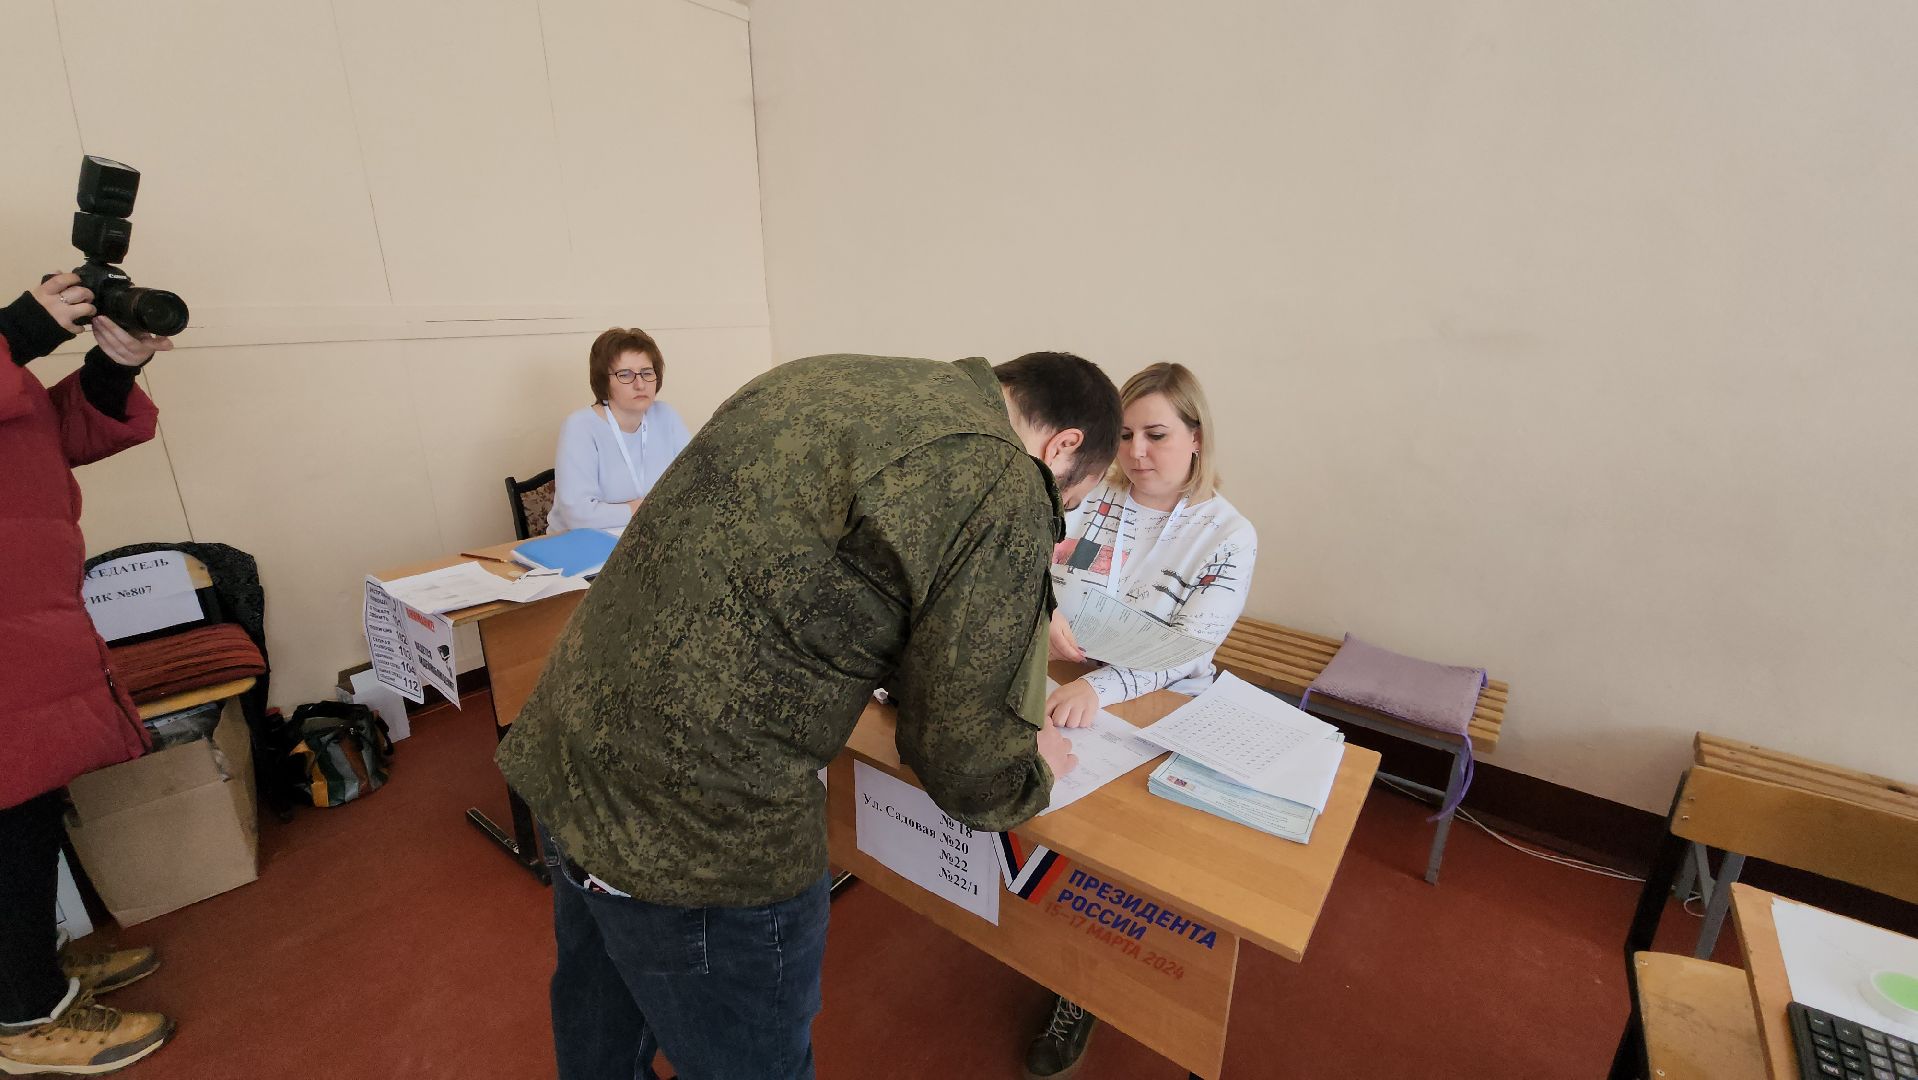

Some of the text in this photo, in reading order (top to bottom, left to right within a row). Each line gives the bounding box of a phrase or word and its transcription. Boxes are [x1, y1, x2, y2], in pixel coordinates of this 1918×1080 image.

[85, 558, 169, 581] СЕДАТЕЛЬ
[84, 585, 152, 605] ИК №807
[403, 677, 419, 692] 112
[863, 793, 969, 855] Ул. Садовая №20
[939, 849, 968, 872] №22
[938, 867, 978, 896] №22/1
[1056, 889, 1147, 941] РОССИИ
[1068, 869, 1217, 950] ПРЕЗИДЕНТА
[1086, 924, 1142, 957] МАРТА
[1143, 952, 1185, 981] 2024
